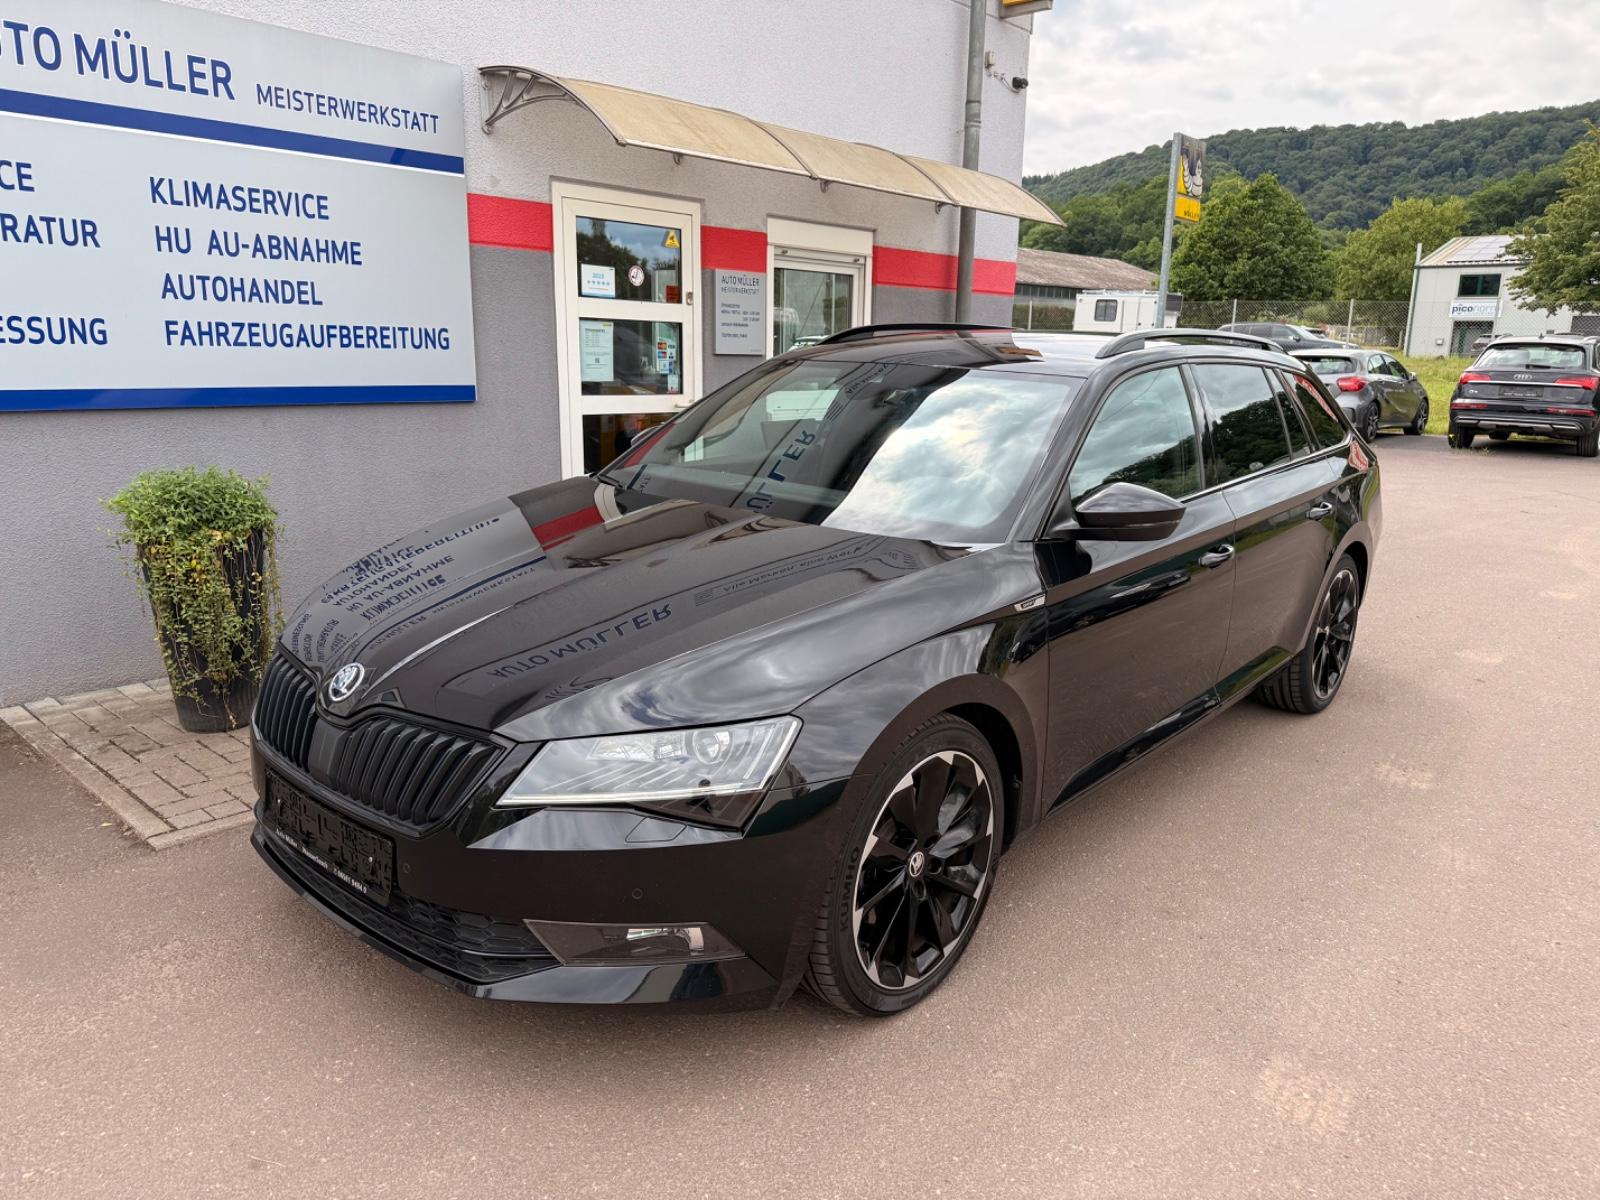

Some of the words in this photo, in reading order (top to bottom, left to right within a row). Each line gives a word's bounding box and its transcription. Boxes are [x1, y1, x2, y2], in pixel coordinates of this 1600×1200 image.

[0, 20, 62, 71] TO
[74, 29, 235, 100] MÜLLER
[256, 84, 439, 134] MEISTERWERKSTATT
[149, 176, 330, 220] KLIMASERVICE
[0, 213, 101, 248] RATUR
[155, 225, 192, 254] HU
[207, 230, 363, 266] AU-ABNAHME
[161, 273, 323, 306] AUTOHANDEL
[722, 275, 737, 285] AUTO
[738, 274, 760, 287] MÜLLER
[165, 320, 450, 350] FAHRZEUGAUFBEREITUNG
[840, 847, 860, 932] KUMHO
